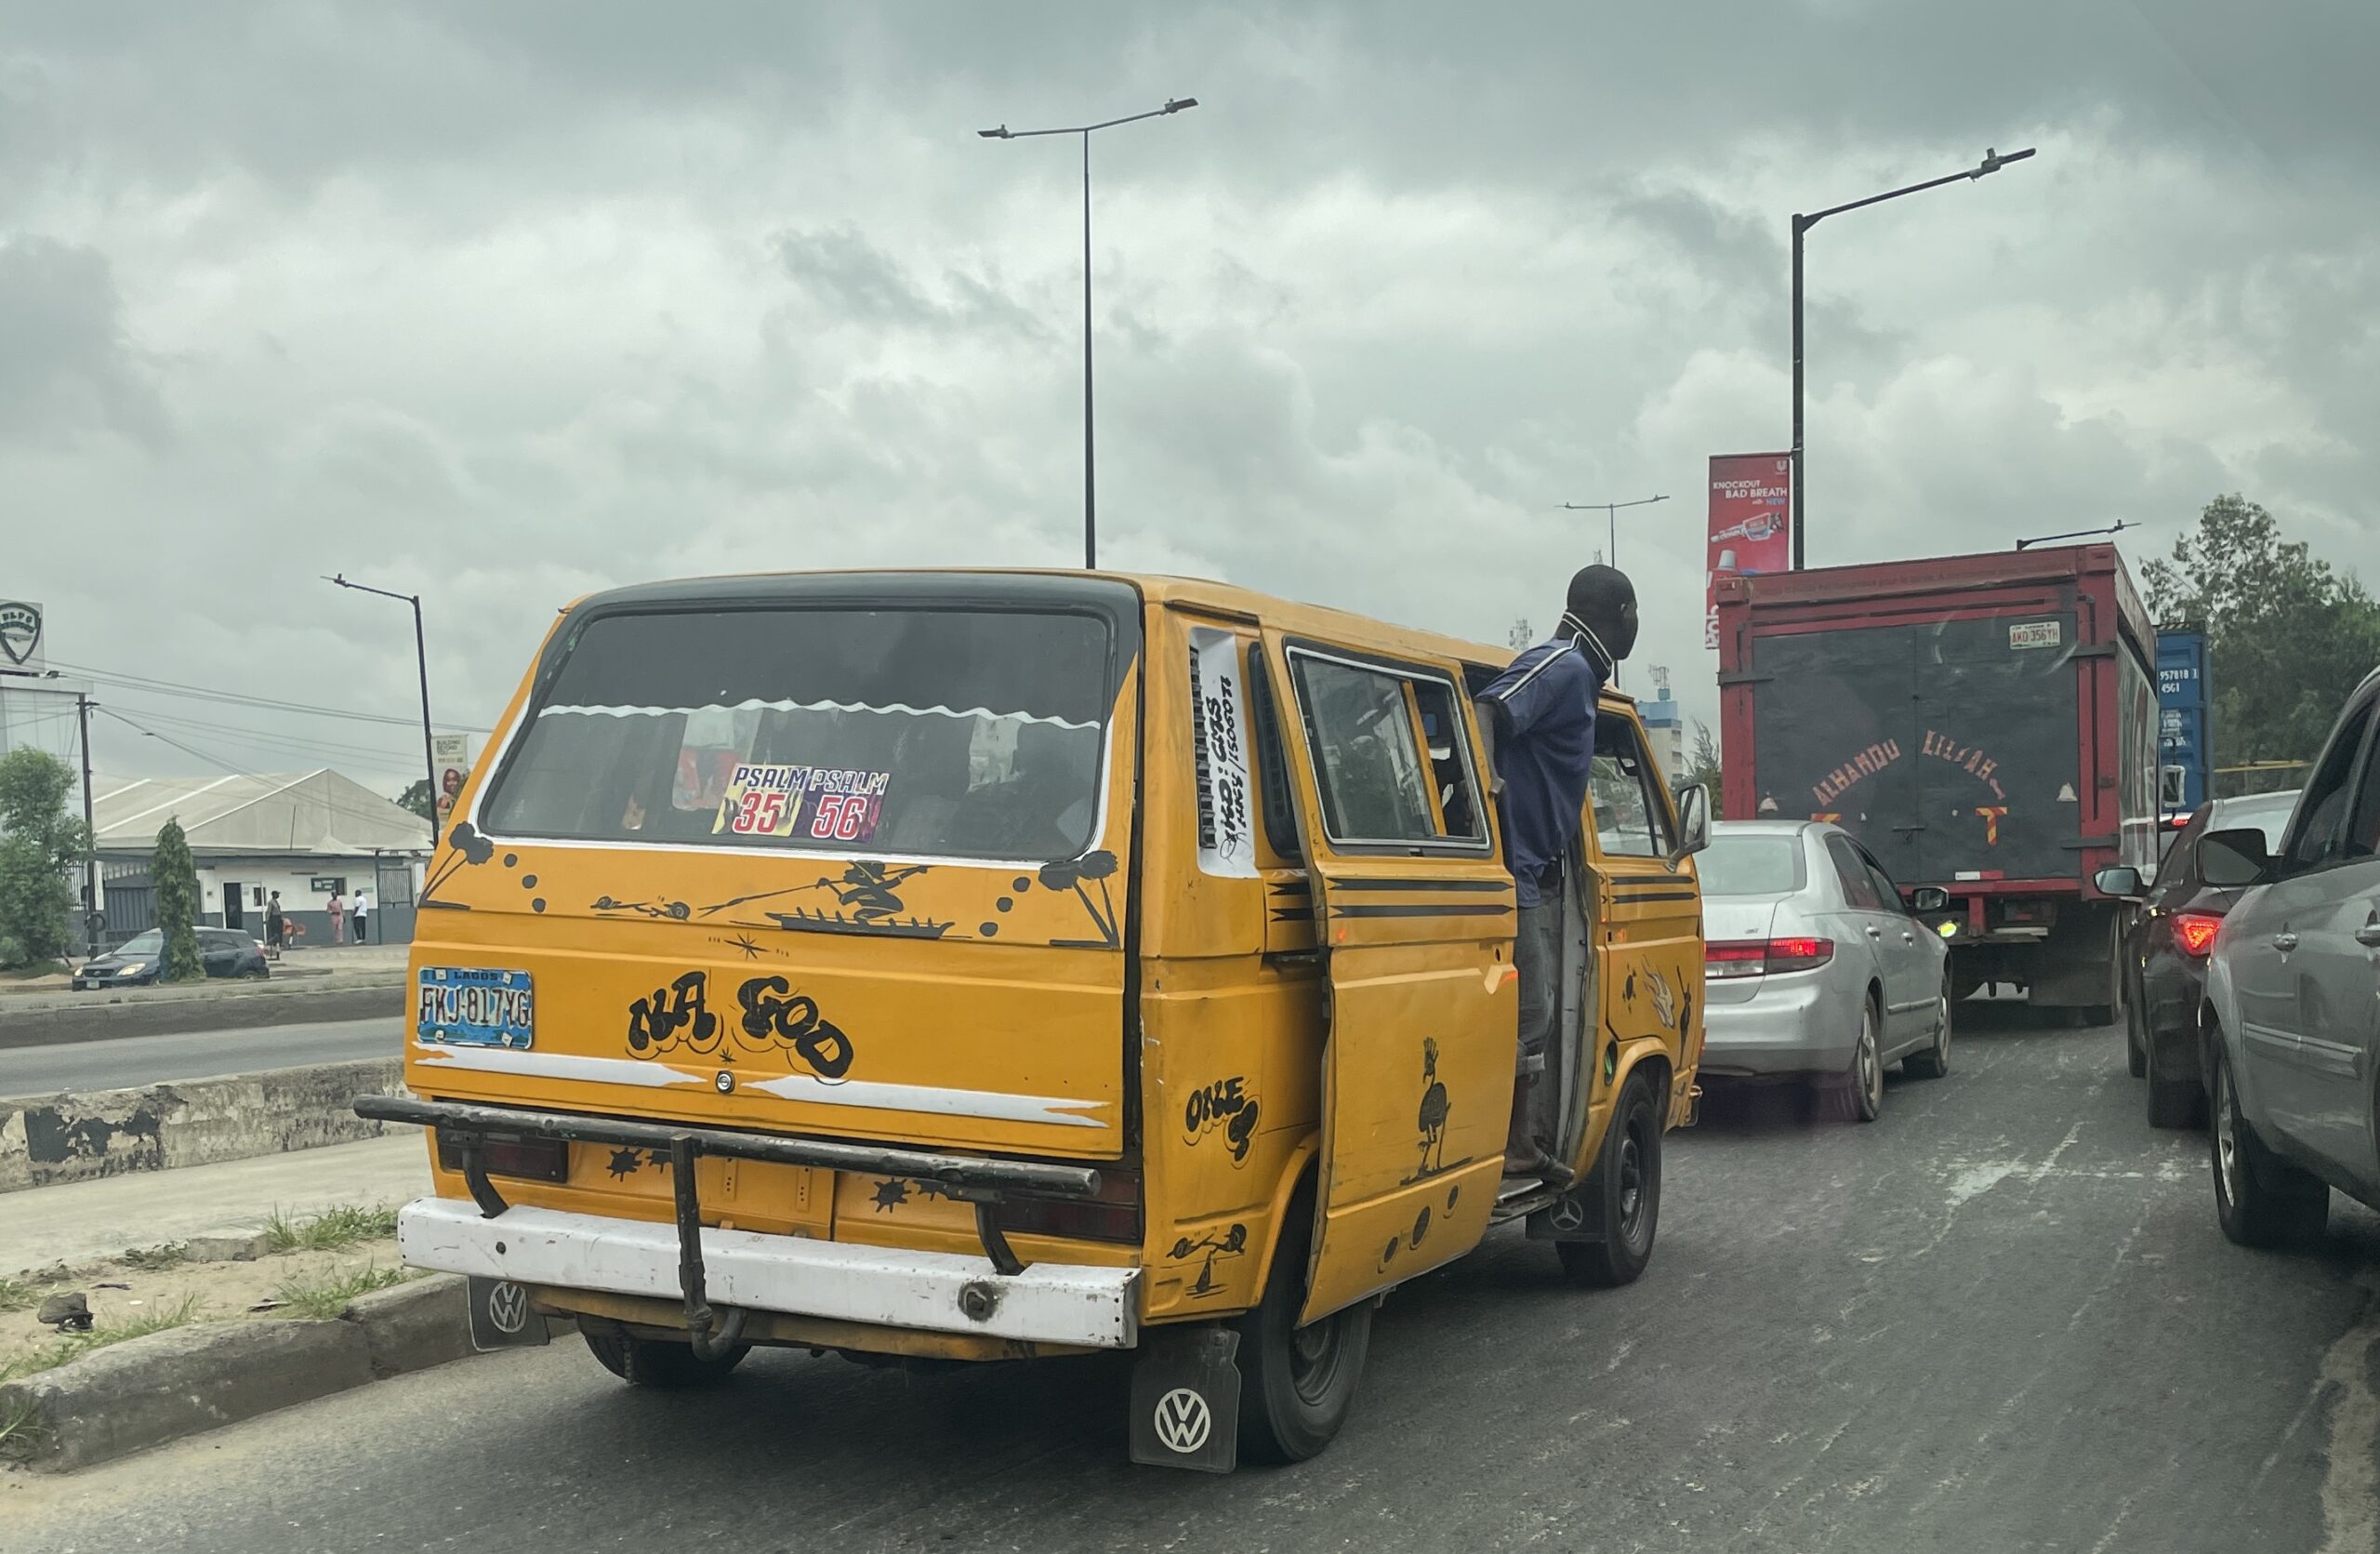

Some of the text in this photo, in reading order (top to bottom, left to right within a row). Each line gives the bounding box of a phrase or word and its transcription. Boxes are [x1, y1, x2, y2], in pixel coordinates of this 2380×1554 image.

[1712, 480, 1761, 489] KNOCKOUT
[1726, 487, 1787, 498] BAD BREATH
[1766, 498, 1785, 506] NEW
[733, 767, 809, 790] PSALM
[808, 769, 890, 795] PSALM
[1813, 738, 1901, 806] ALHAMDU
[733, 791, 787, 834] 35
[811, 795, 867, 840] 56
[454, 972, 497, 980] LAGOS
[628, 971, 853, 1079] NA GOD
